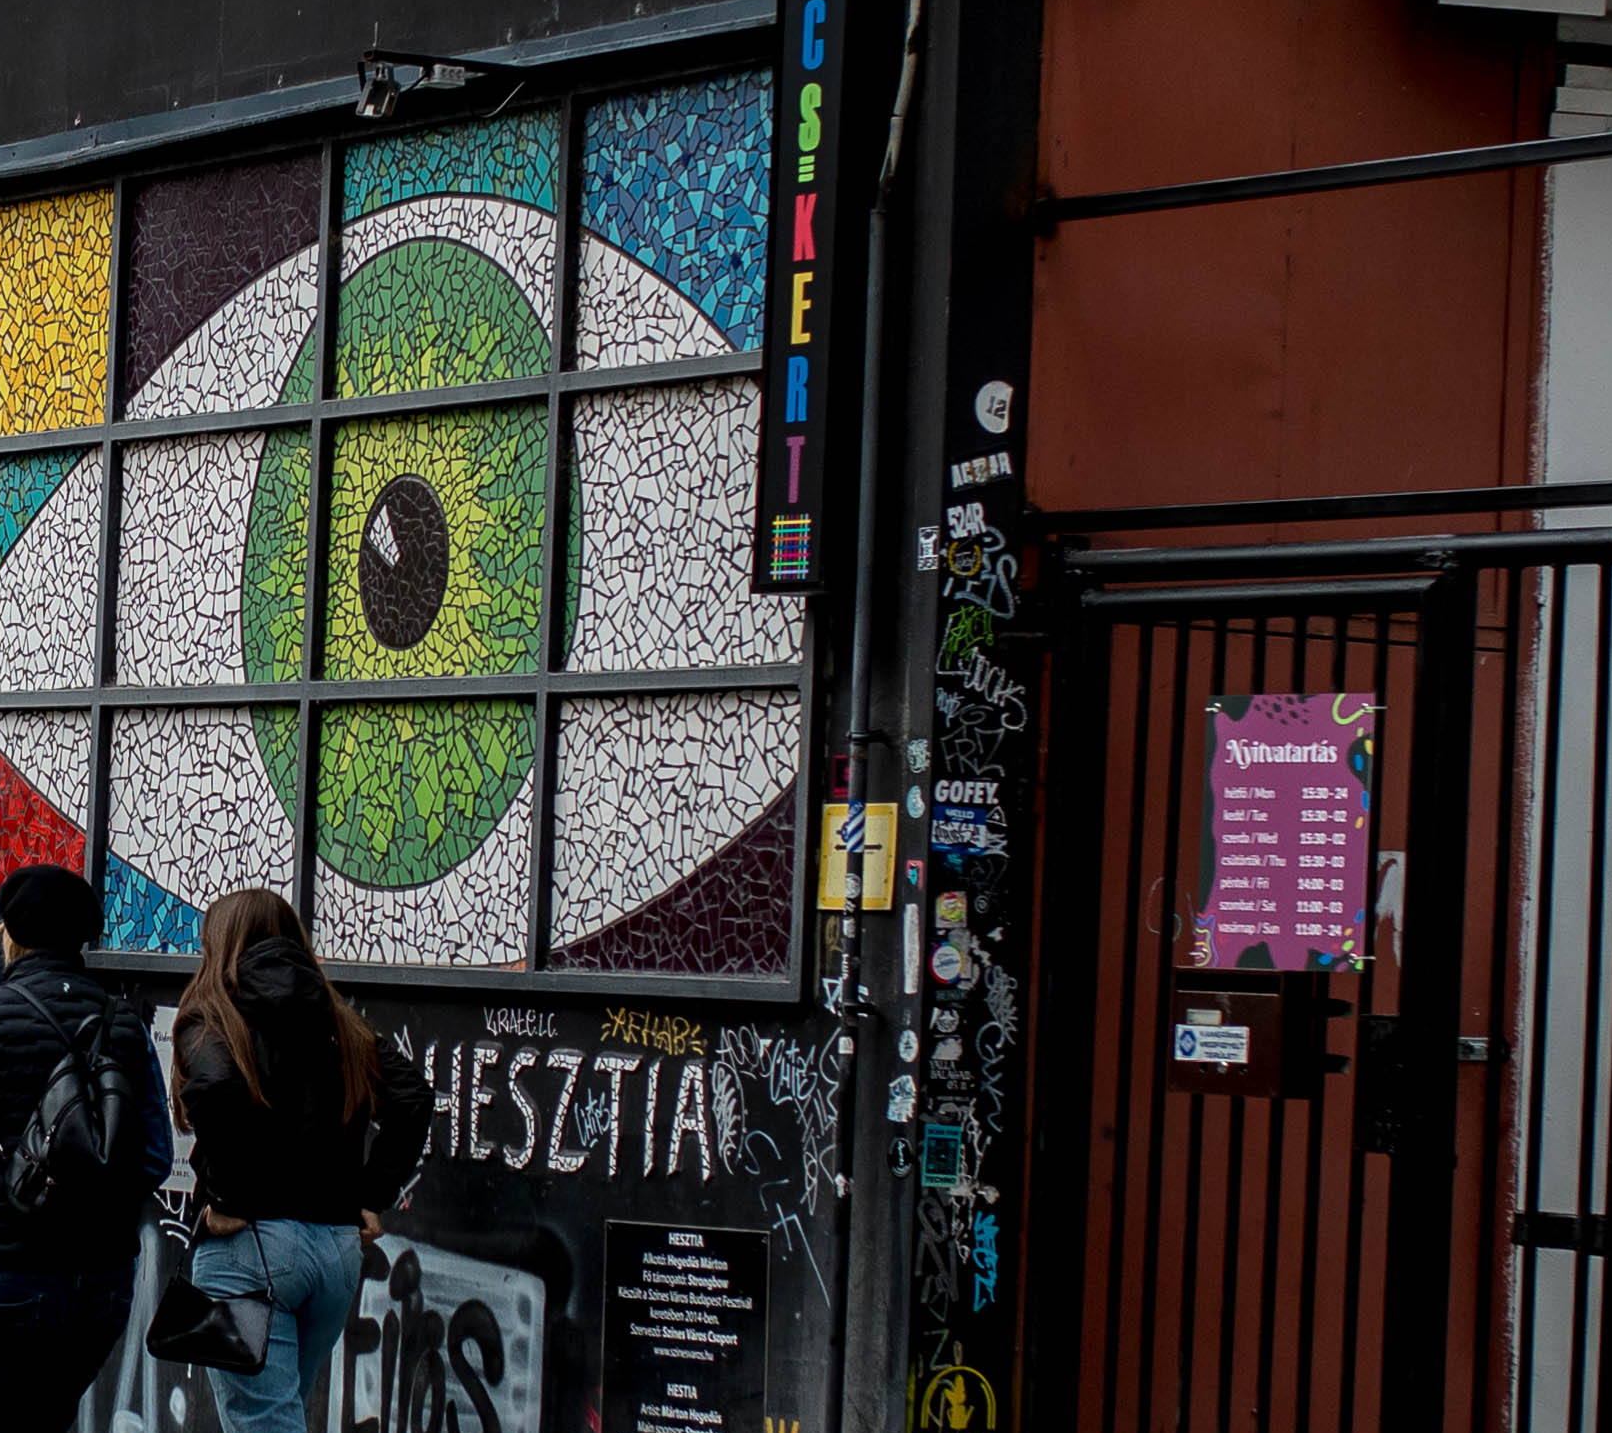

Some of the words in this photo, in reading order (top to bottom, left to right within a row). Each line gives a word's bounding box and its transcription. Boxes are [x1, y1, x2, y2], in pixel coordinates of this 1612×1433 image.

[1225, 739, 1338, 770] Nyitvatartás
[934, 779, 999, 804] GOFEY.
[416, 1040, 712, 1181] HESZTIA
[668, 1232, 704, 1247] HESZTIA
[700, 1257, 728, 1270] Márton
[688, 1274, 728, 1290] Strongbow
[643, 1291, 647, 1300] a
[689, 1292, 721, 1308] Budapest
[708, 1331, 737, 1346] Csoport
[667, 1383, 697, 1399] HESTIA
[662, 1406, 688, 1419] Márton
[637, 1421, 655, 1433] Main
